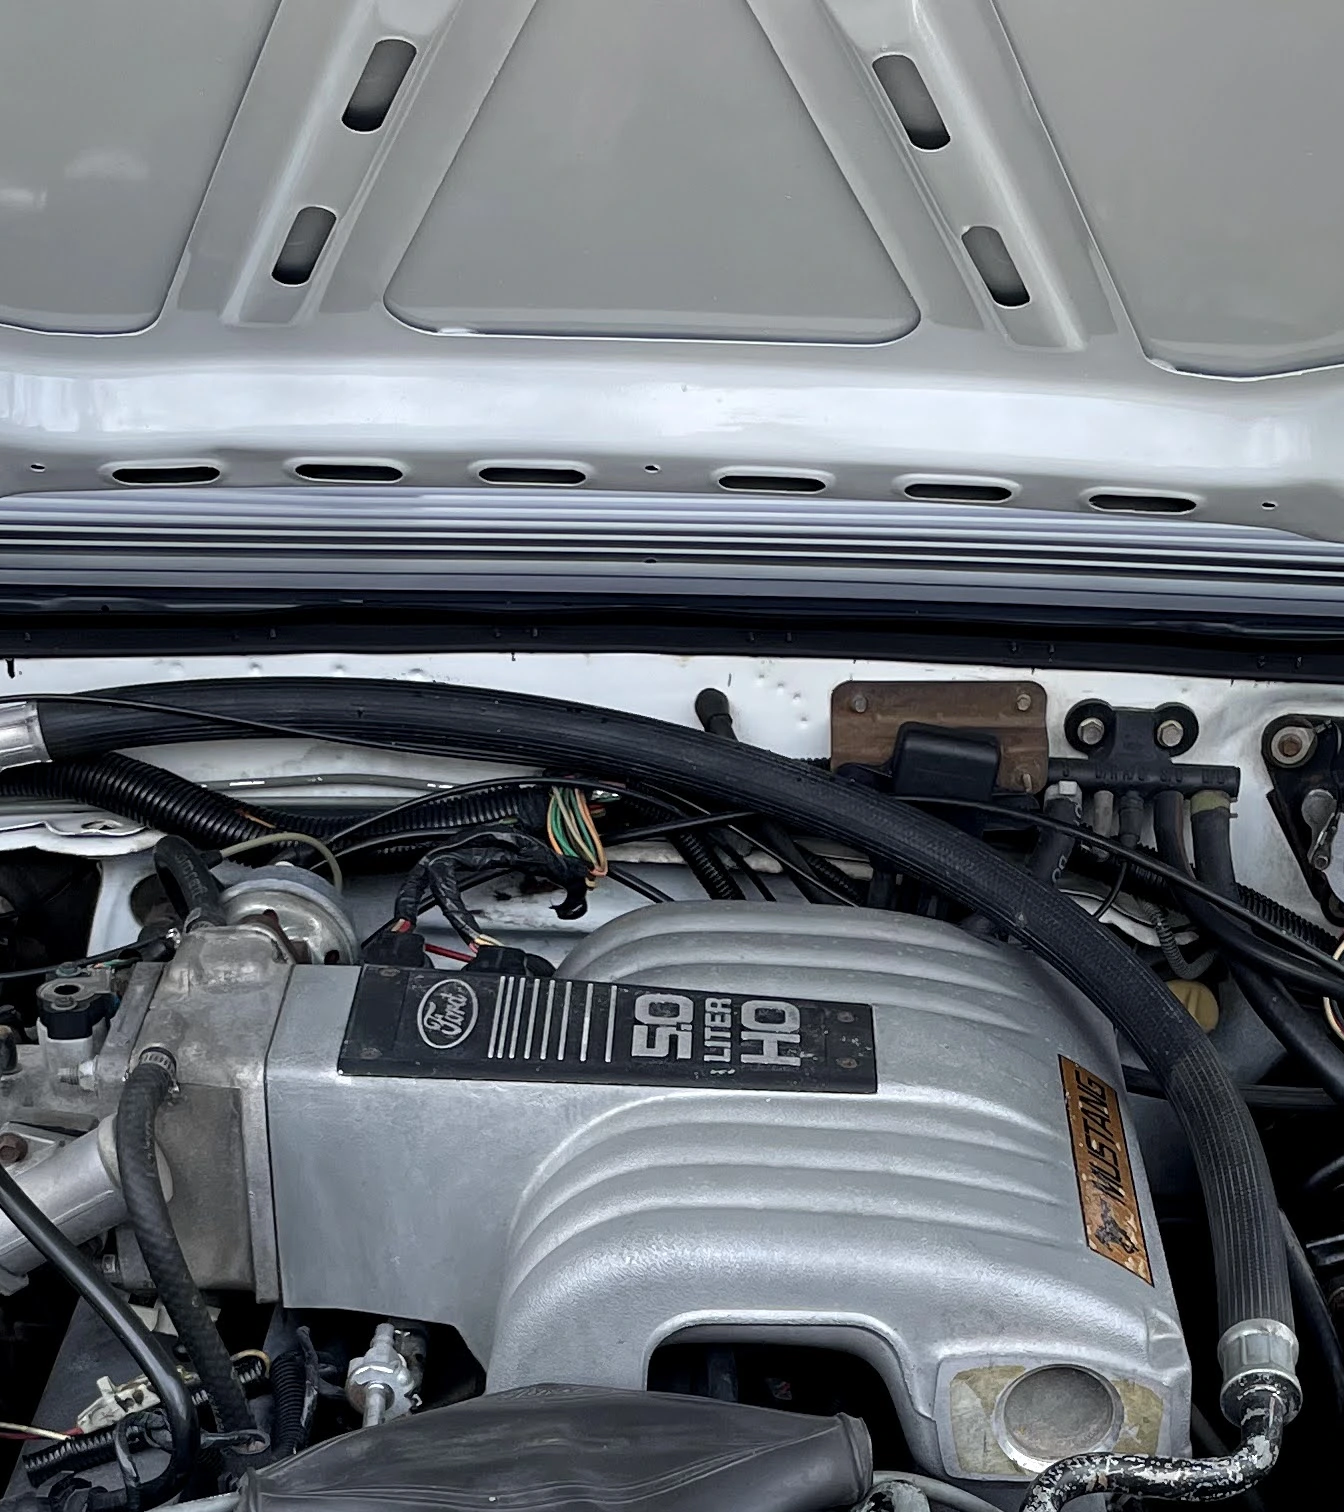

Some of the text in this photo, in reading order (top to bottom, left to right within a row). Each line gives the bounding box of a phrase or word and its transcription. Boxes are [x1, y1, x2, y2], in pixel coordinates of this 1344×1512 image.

[422, 984, 468, 1039] Ford
[631, 993, 693, 1060] 5.0
[704, 998, 732, 1063] LITER
[740, 1000, 801, 1067] HO
[1075, 1069, 1125, 1206] MUSTANG
